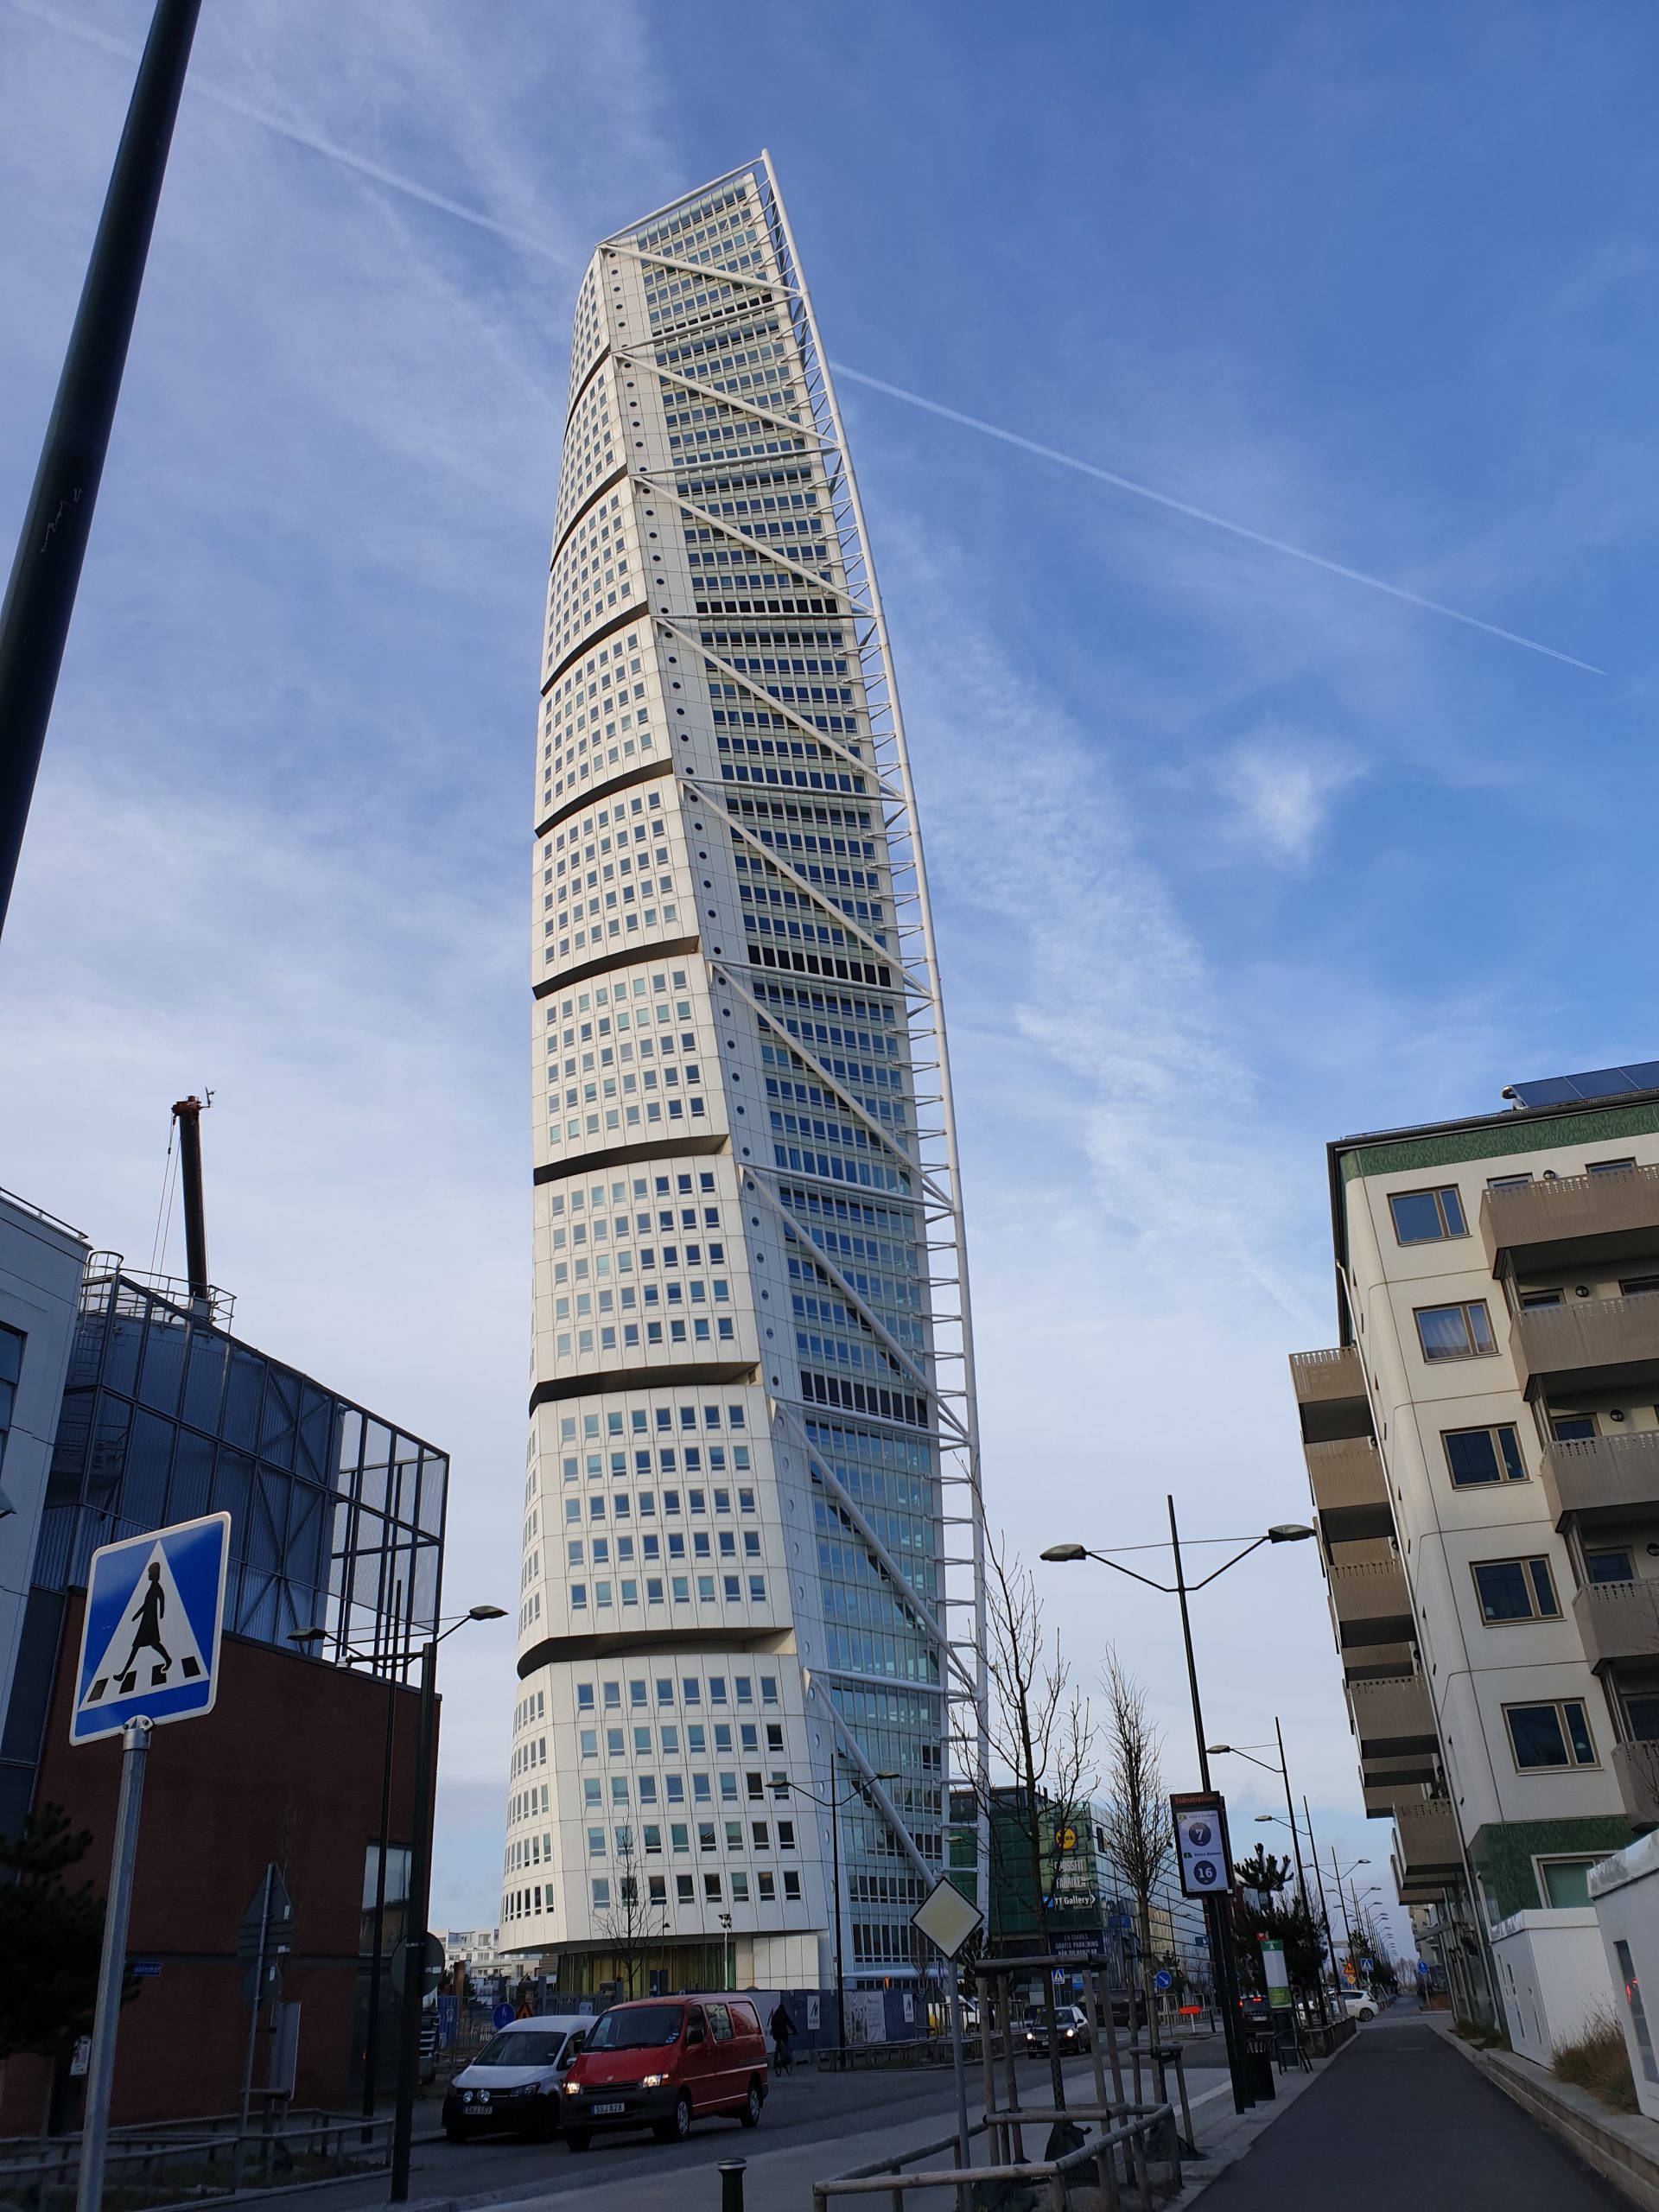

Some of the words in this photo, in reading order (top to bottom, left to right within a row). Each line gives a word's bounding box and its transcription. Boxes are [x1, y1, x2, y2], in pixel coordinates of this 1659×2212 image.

[1196, 1828, 1204, 1840] 7
[1198, 1866, 1213, 1878] 16
[1056, 1876, 1086, 1889] FABRIKEN
[1064, 1895, 1090, 1905] Gallery
